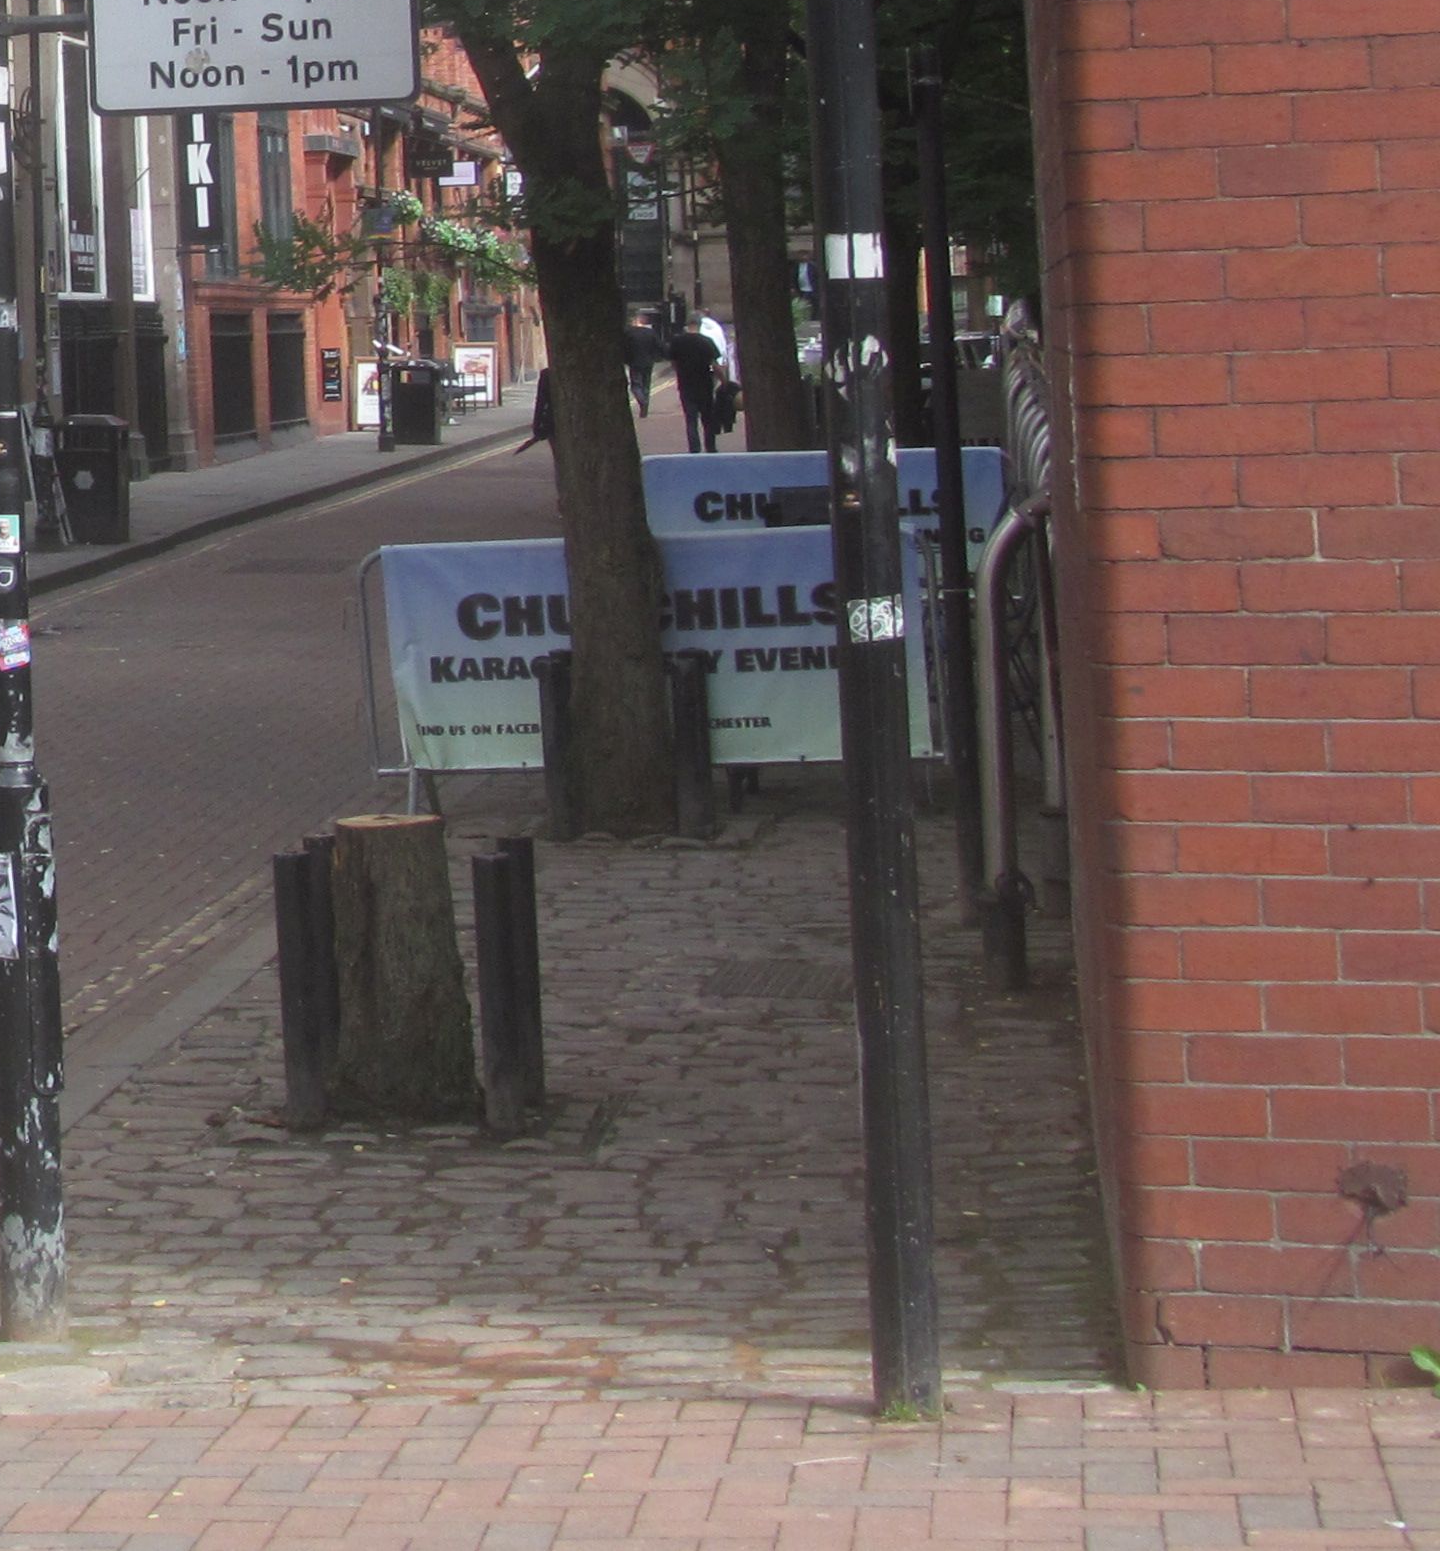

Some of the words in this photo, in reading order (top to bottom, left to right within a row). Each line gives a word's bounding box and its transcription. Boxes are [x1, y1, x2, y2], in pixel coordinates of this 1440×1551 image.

[173, 16, 219, 46] Fri
[261, 13, 333, 42] Sun
[149, 60, 245, 90] Noon
[287, 54, 359, 88] 1pm
[187, 113, 214, 228] IKI
[457, 582, 839, 641] CHUHILLS
[735, 647, 840, 672] EVENI
[448, 724, 467, 736] US
[471, 724, 492, 736] ON
[496, 723, 541, 735] FACEB
